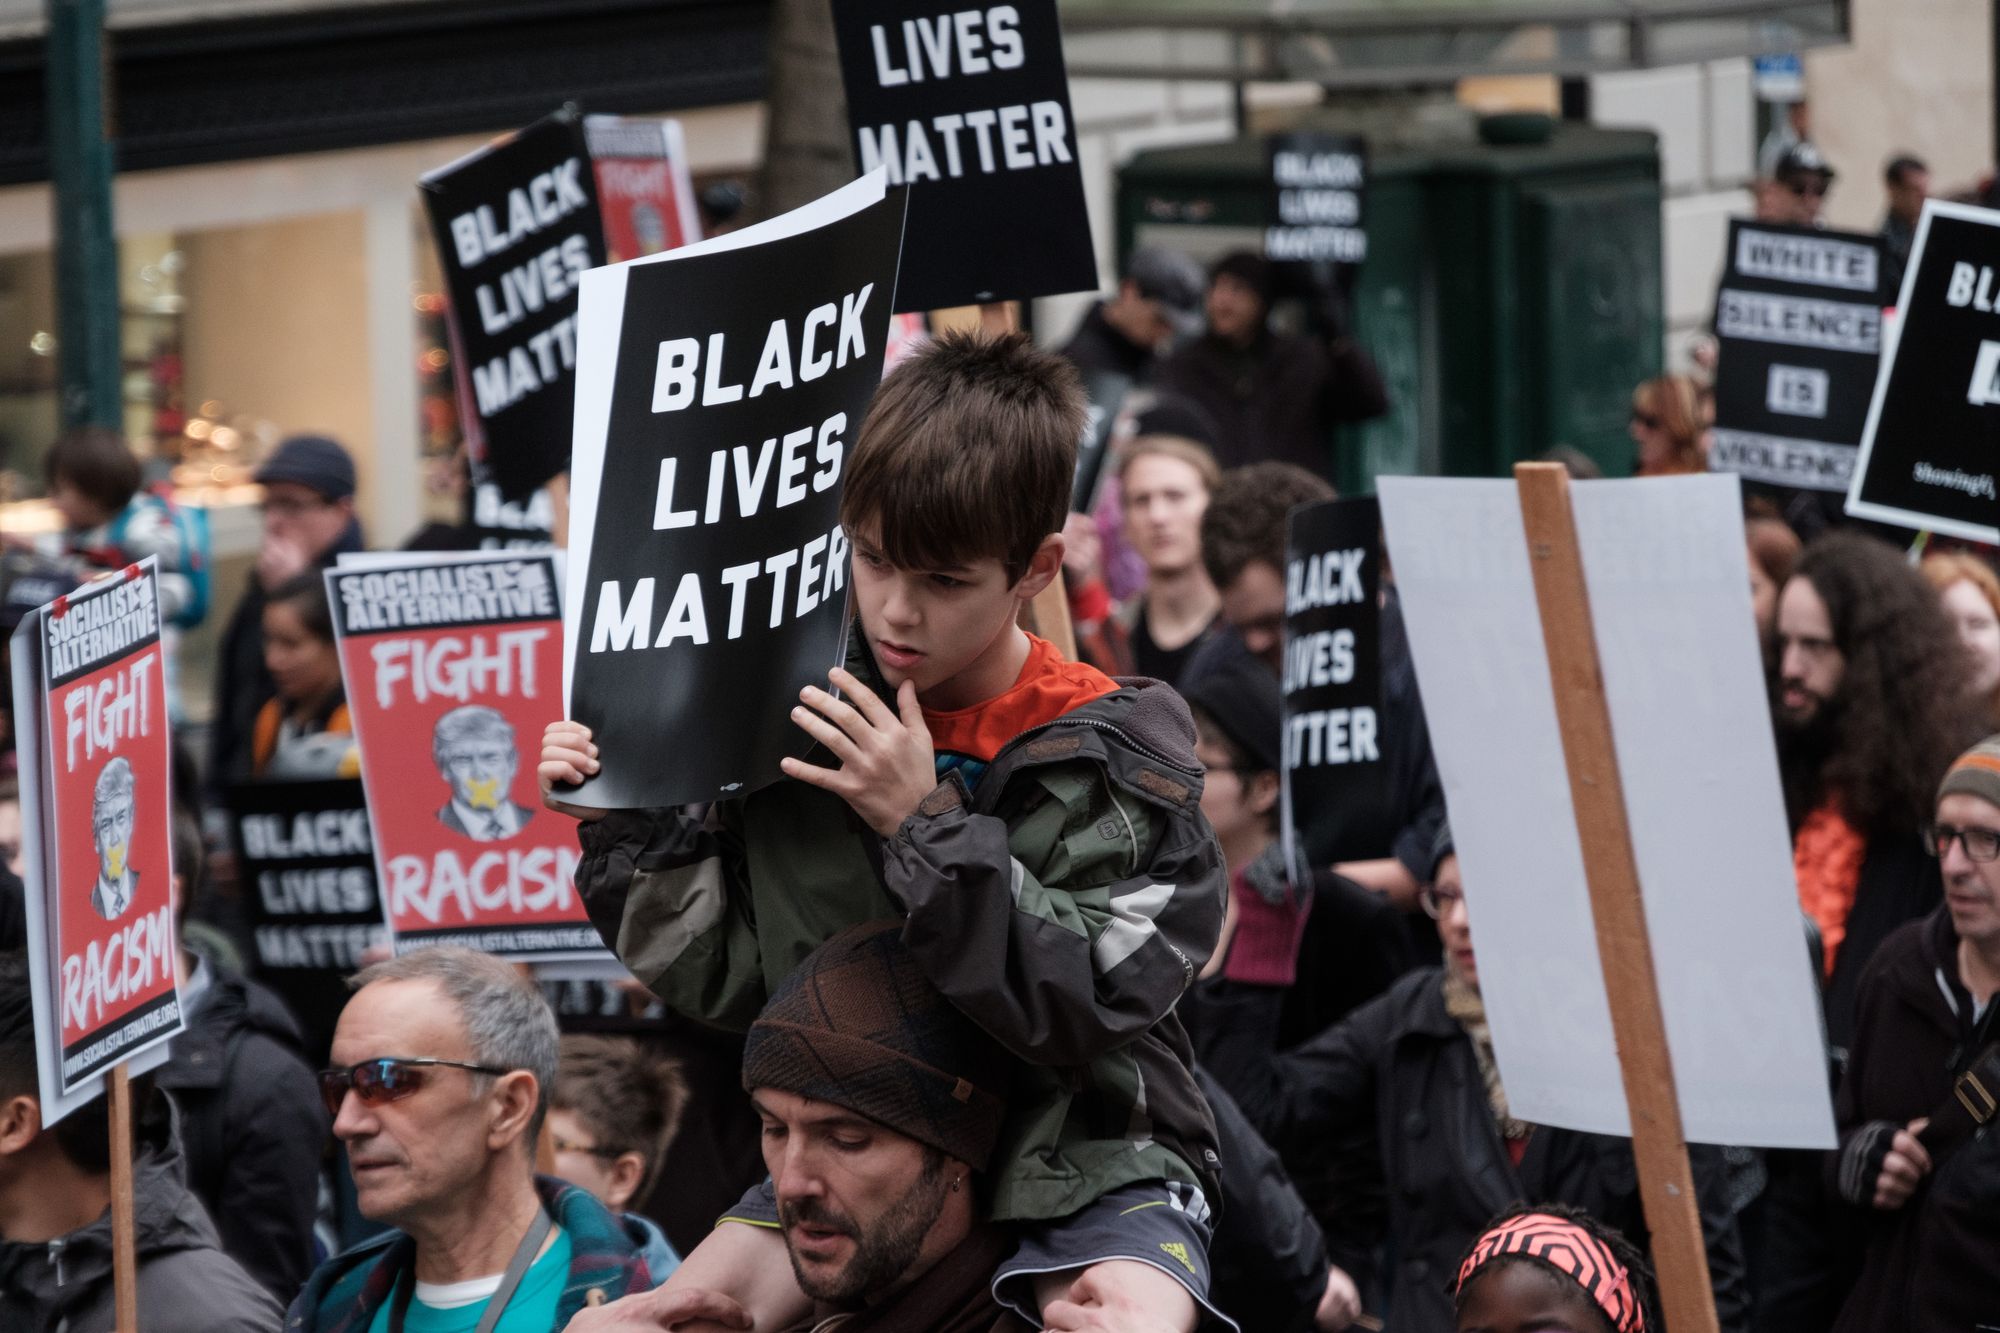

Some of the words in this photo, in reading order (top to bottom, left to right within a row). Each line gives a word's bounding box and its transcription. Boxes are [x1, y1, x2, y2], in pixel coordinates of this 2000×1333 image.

[870, 5, 1025, 87] LIVES
[858, 100, 1072, 187] MATTER
[450, 157, 588, 269] BLACK
[475, 233, 592, 334] LIVES
[1749, 244, 1867, 277] WHITE
[1946, 260, 2000, 315] BL
[652, 282, 874, 413] BLACK
[1725, 301, 1879, 339] SILENCE
[472, 310, 577, 418] MATT
[1781, 379, 1812, 402] IS
[652, 411, 847, 530] LIVES
[1716, 443, 1854, 476] VIOLENC
[48, 583, 138, 648] SOCIALIST
[339, 562, 506, 606] SOCIALIST
[346, 587, 555, 632] ALTERNATIVE
[590, 524, 849, 654] MATTER
[51, 603, 156, 680] ALTERNATIVE
[370, 627, 550, 710] FIGHT
[64, 653, 154, 773] FIGHT
[240, 808, 371, 859] BLACK
[258, 865, 374, 915] LIVES
[63, 905, 169, 1030] RACISM
[64, 1002, 178, 1080] WWW.SOCIALISTALTERNATIVE.ORG
